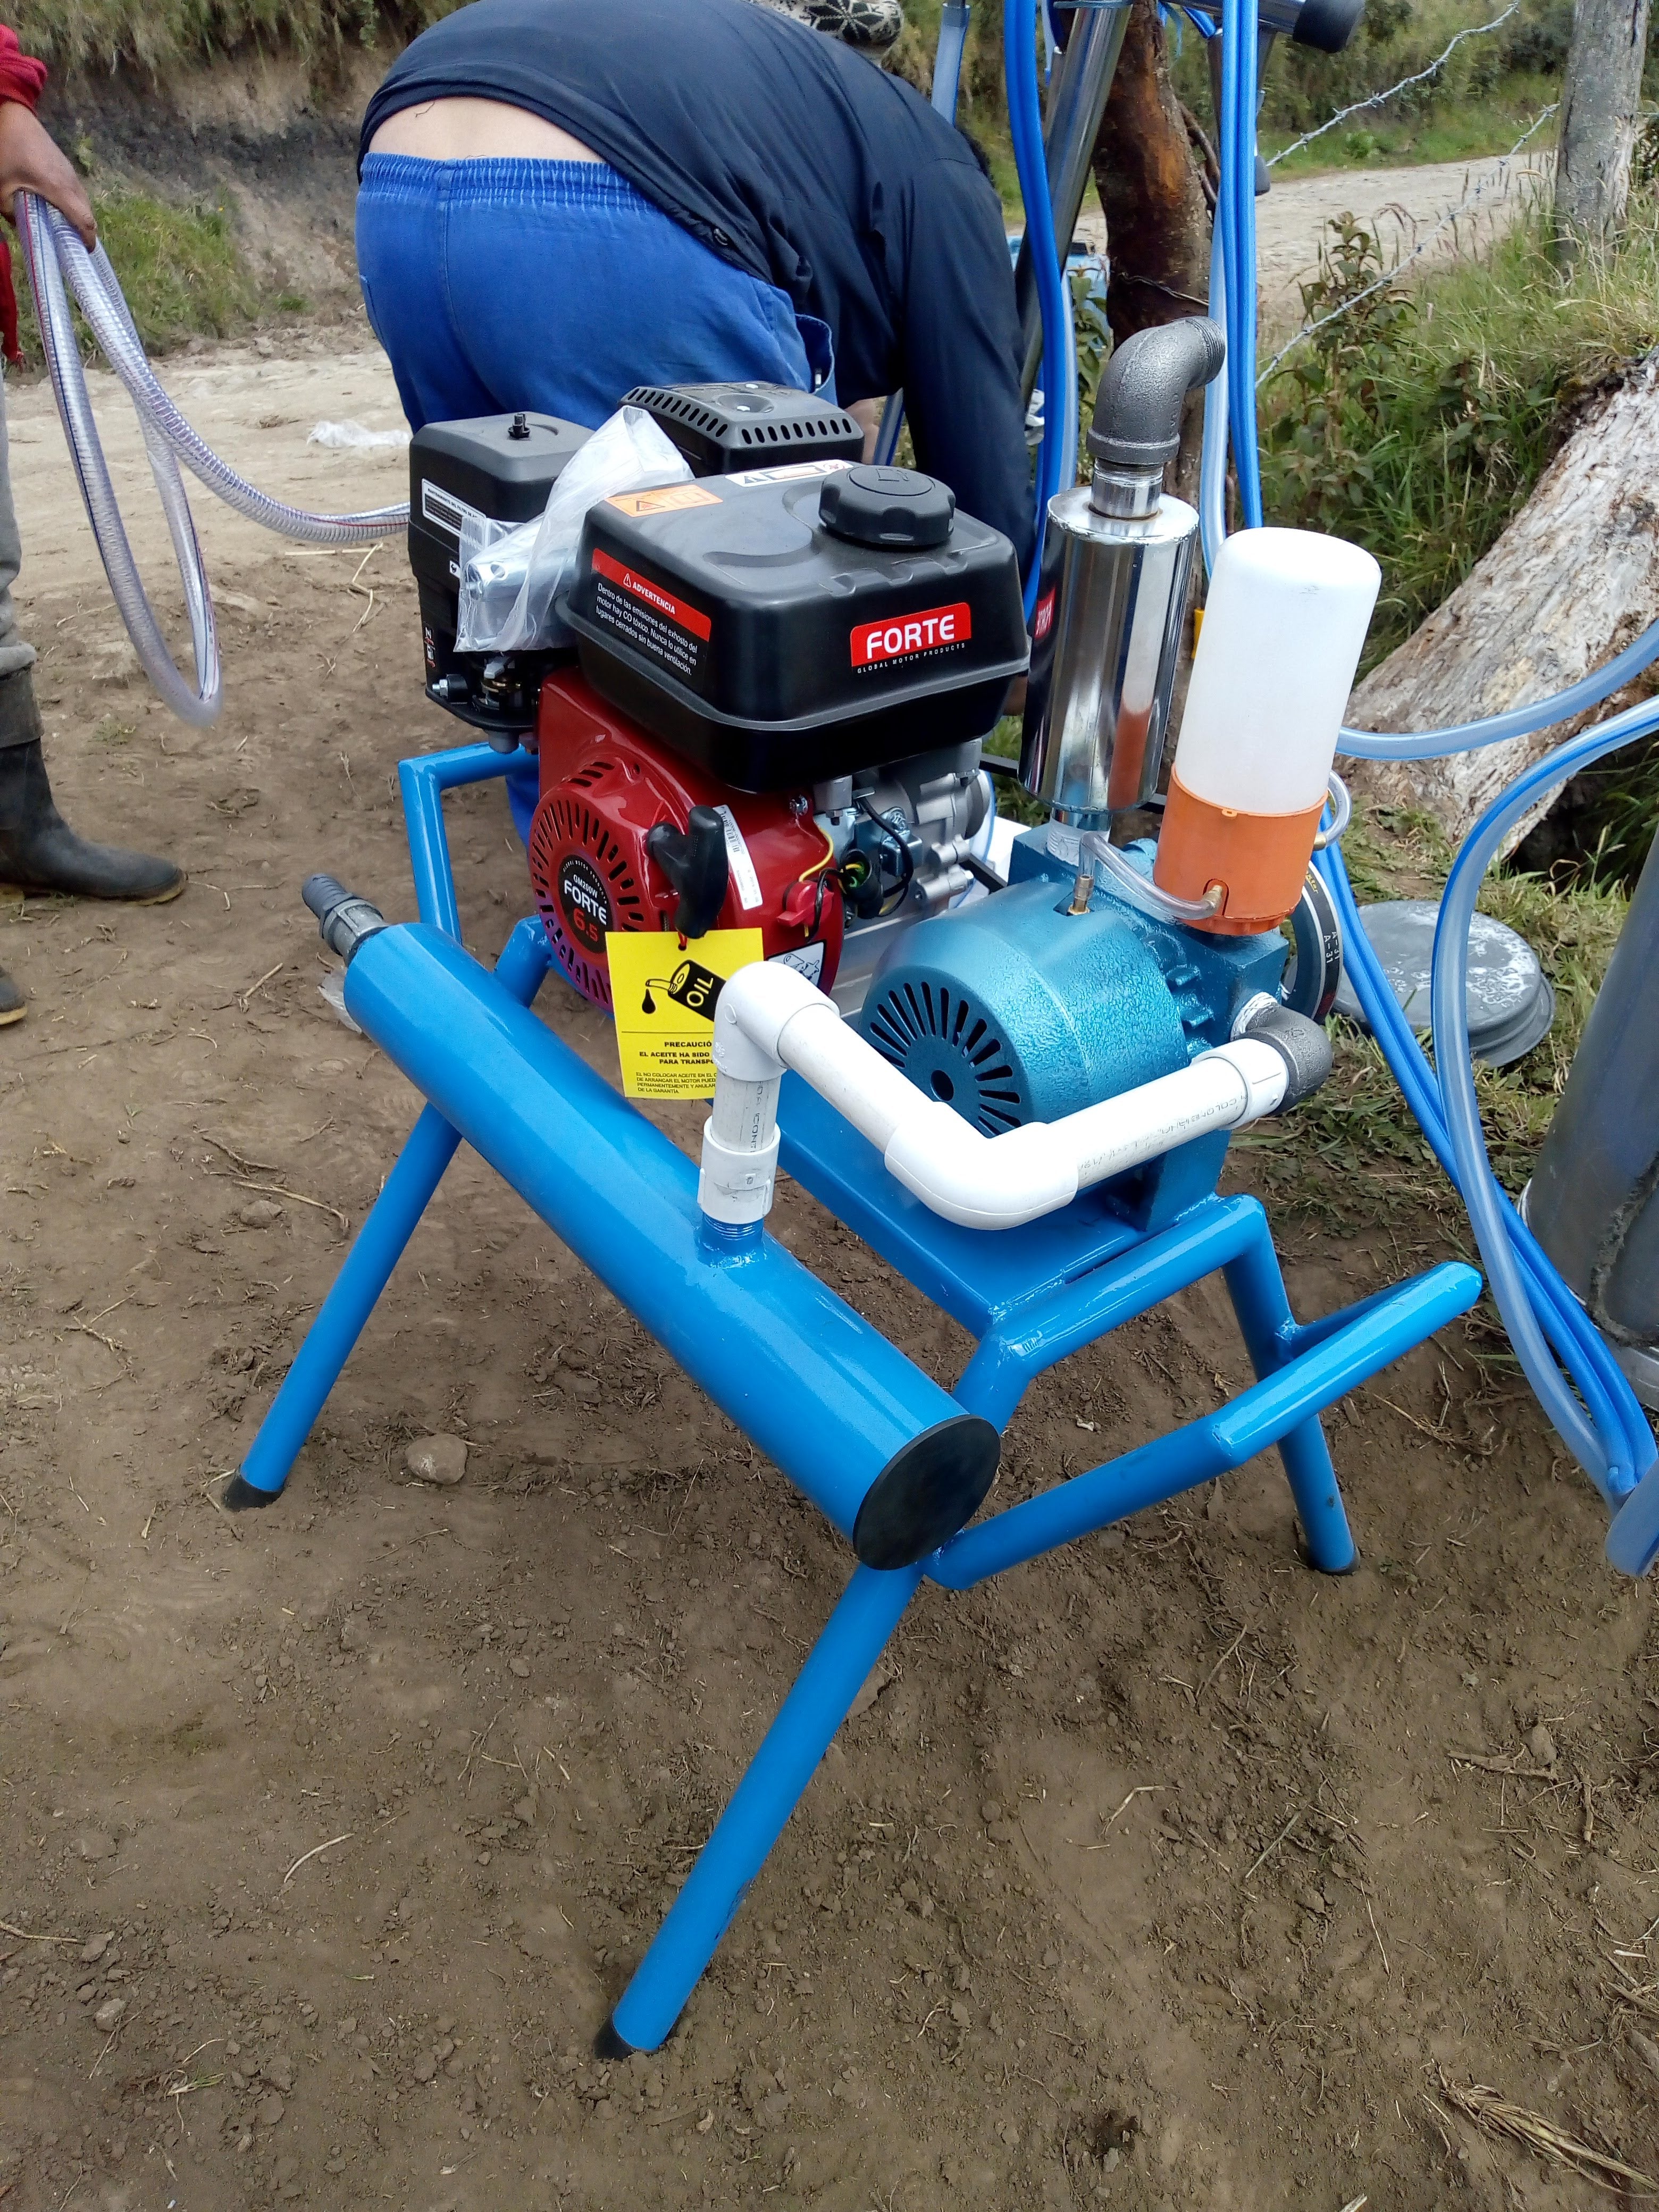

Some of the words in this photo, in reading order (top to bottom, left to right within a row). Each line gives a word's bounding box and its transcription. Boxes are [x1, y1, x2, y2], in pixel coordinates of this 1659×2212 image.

[632, 582, 675, 615] ADVERTENCIA
[597, 595, 612, 609] motor
[613, 604, 623, 618] hay
[623, 610, 632, 623] CO
[633, 616, 650, 634] tóxico.
[650, 627, 667, 646] Nunca
[668, 639, 673, 649] lo
[674, 644, 689, 661] utilice
[689, 656, 697, 666] en
[598, 582, 615, 600] Dentro
[616, 594, 623, 605] de
[632, 607, 658, 627] emisiones
[659, 622, 667, 633] del
[668, 629, 688, 648] exhosto
[689, 642, 698, 653] del
[596, 605, 615, 624] lugares
[616, 619, 638, 638] cerrados
[647, 638, 663, 656] buena
[664, 651, 692, 676] ventilación.
[867, 614, 954, 659] FORTE
[857, 661, 888, 674] GLOBAL
[893, 653, 919, 665] MOTOR
[924, 642, 966, 657] PRODUCTS
[564, 879, 607, 926] FORTE
[573, 874, 598, 899] GM200W
[573, 907, 599, 942] 6.5
[1323, 935, 1334, 963] A-31
[686, 977, 714, 1007] OIL
